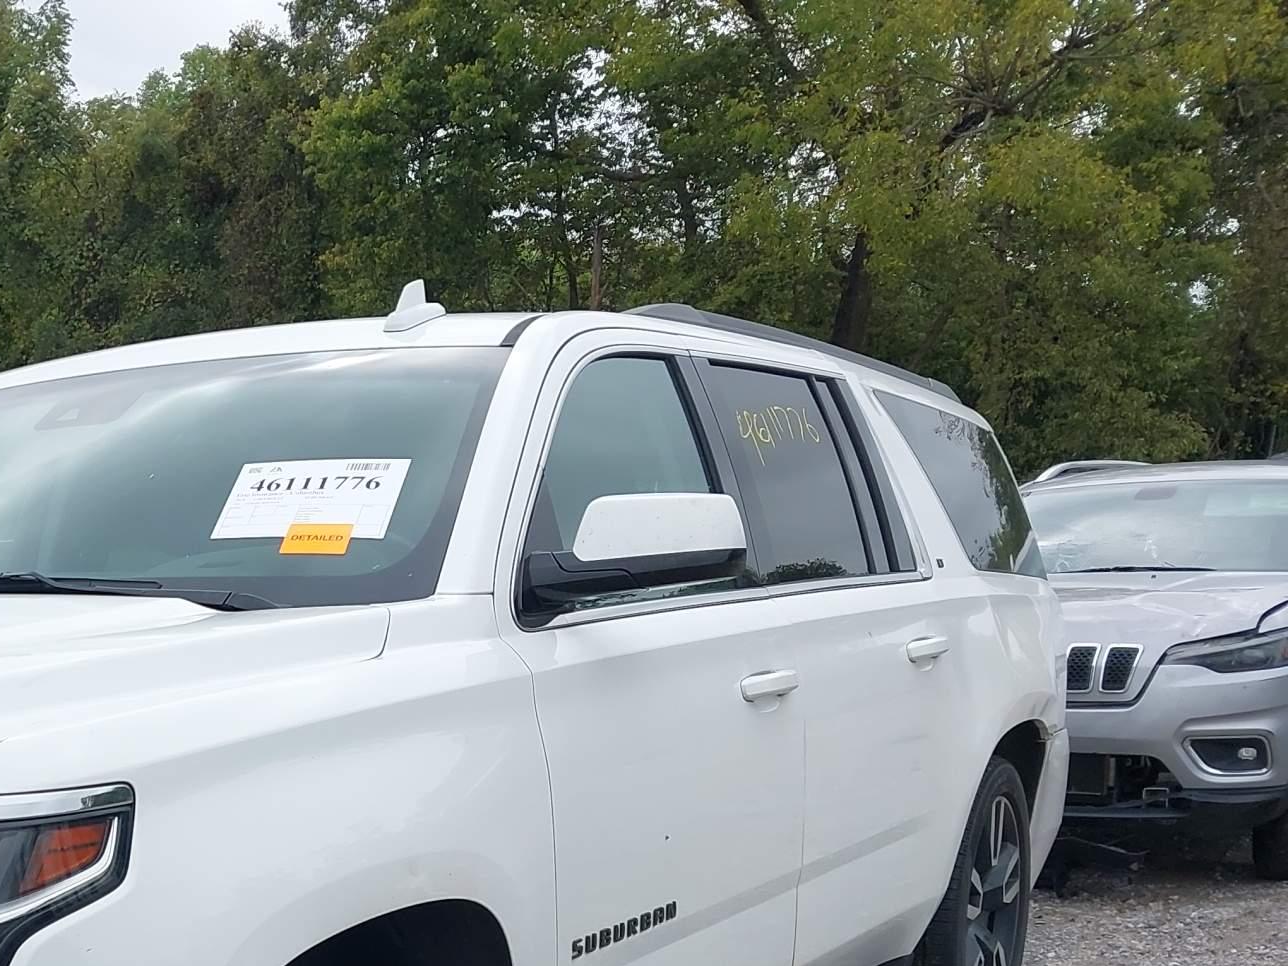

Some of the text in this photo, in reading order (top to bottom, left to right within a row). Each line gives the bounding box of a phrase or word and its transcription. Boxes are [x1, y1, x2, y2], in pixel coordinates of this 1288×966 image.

[249, 475, 385, 492] 46111776
[290, 534, 344, 542] DETAILED
[571, 900, 677, 960] SUBURBAN
